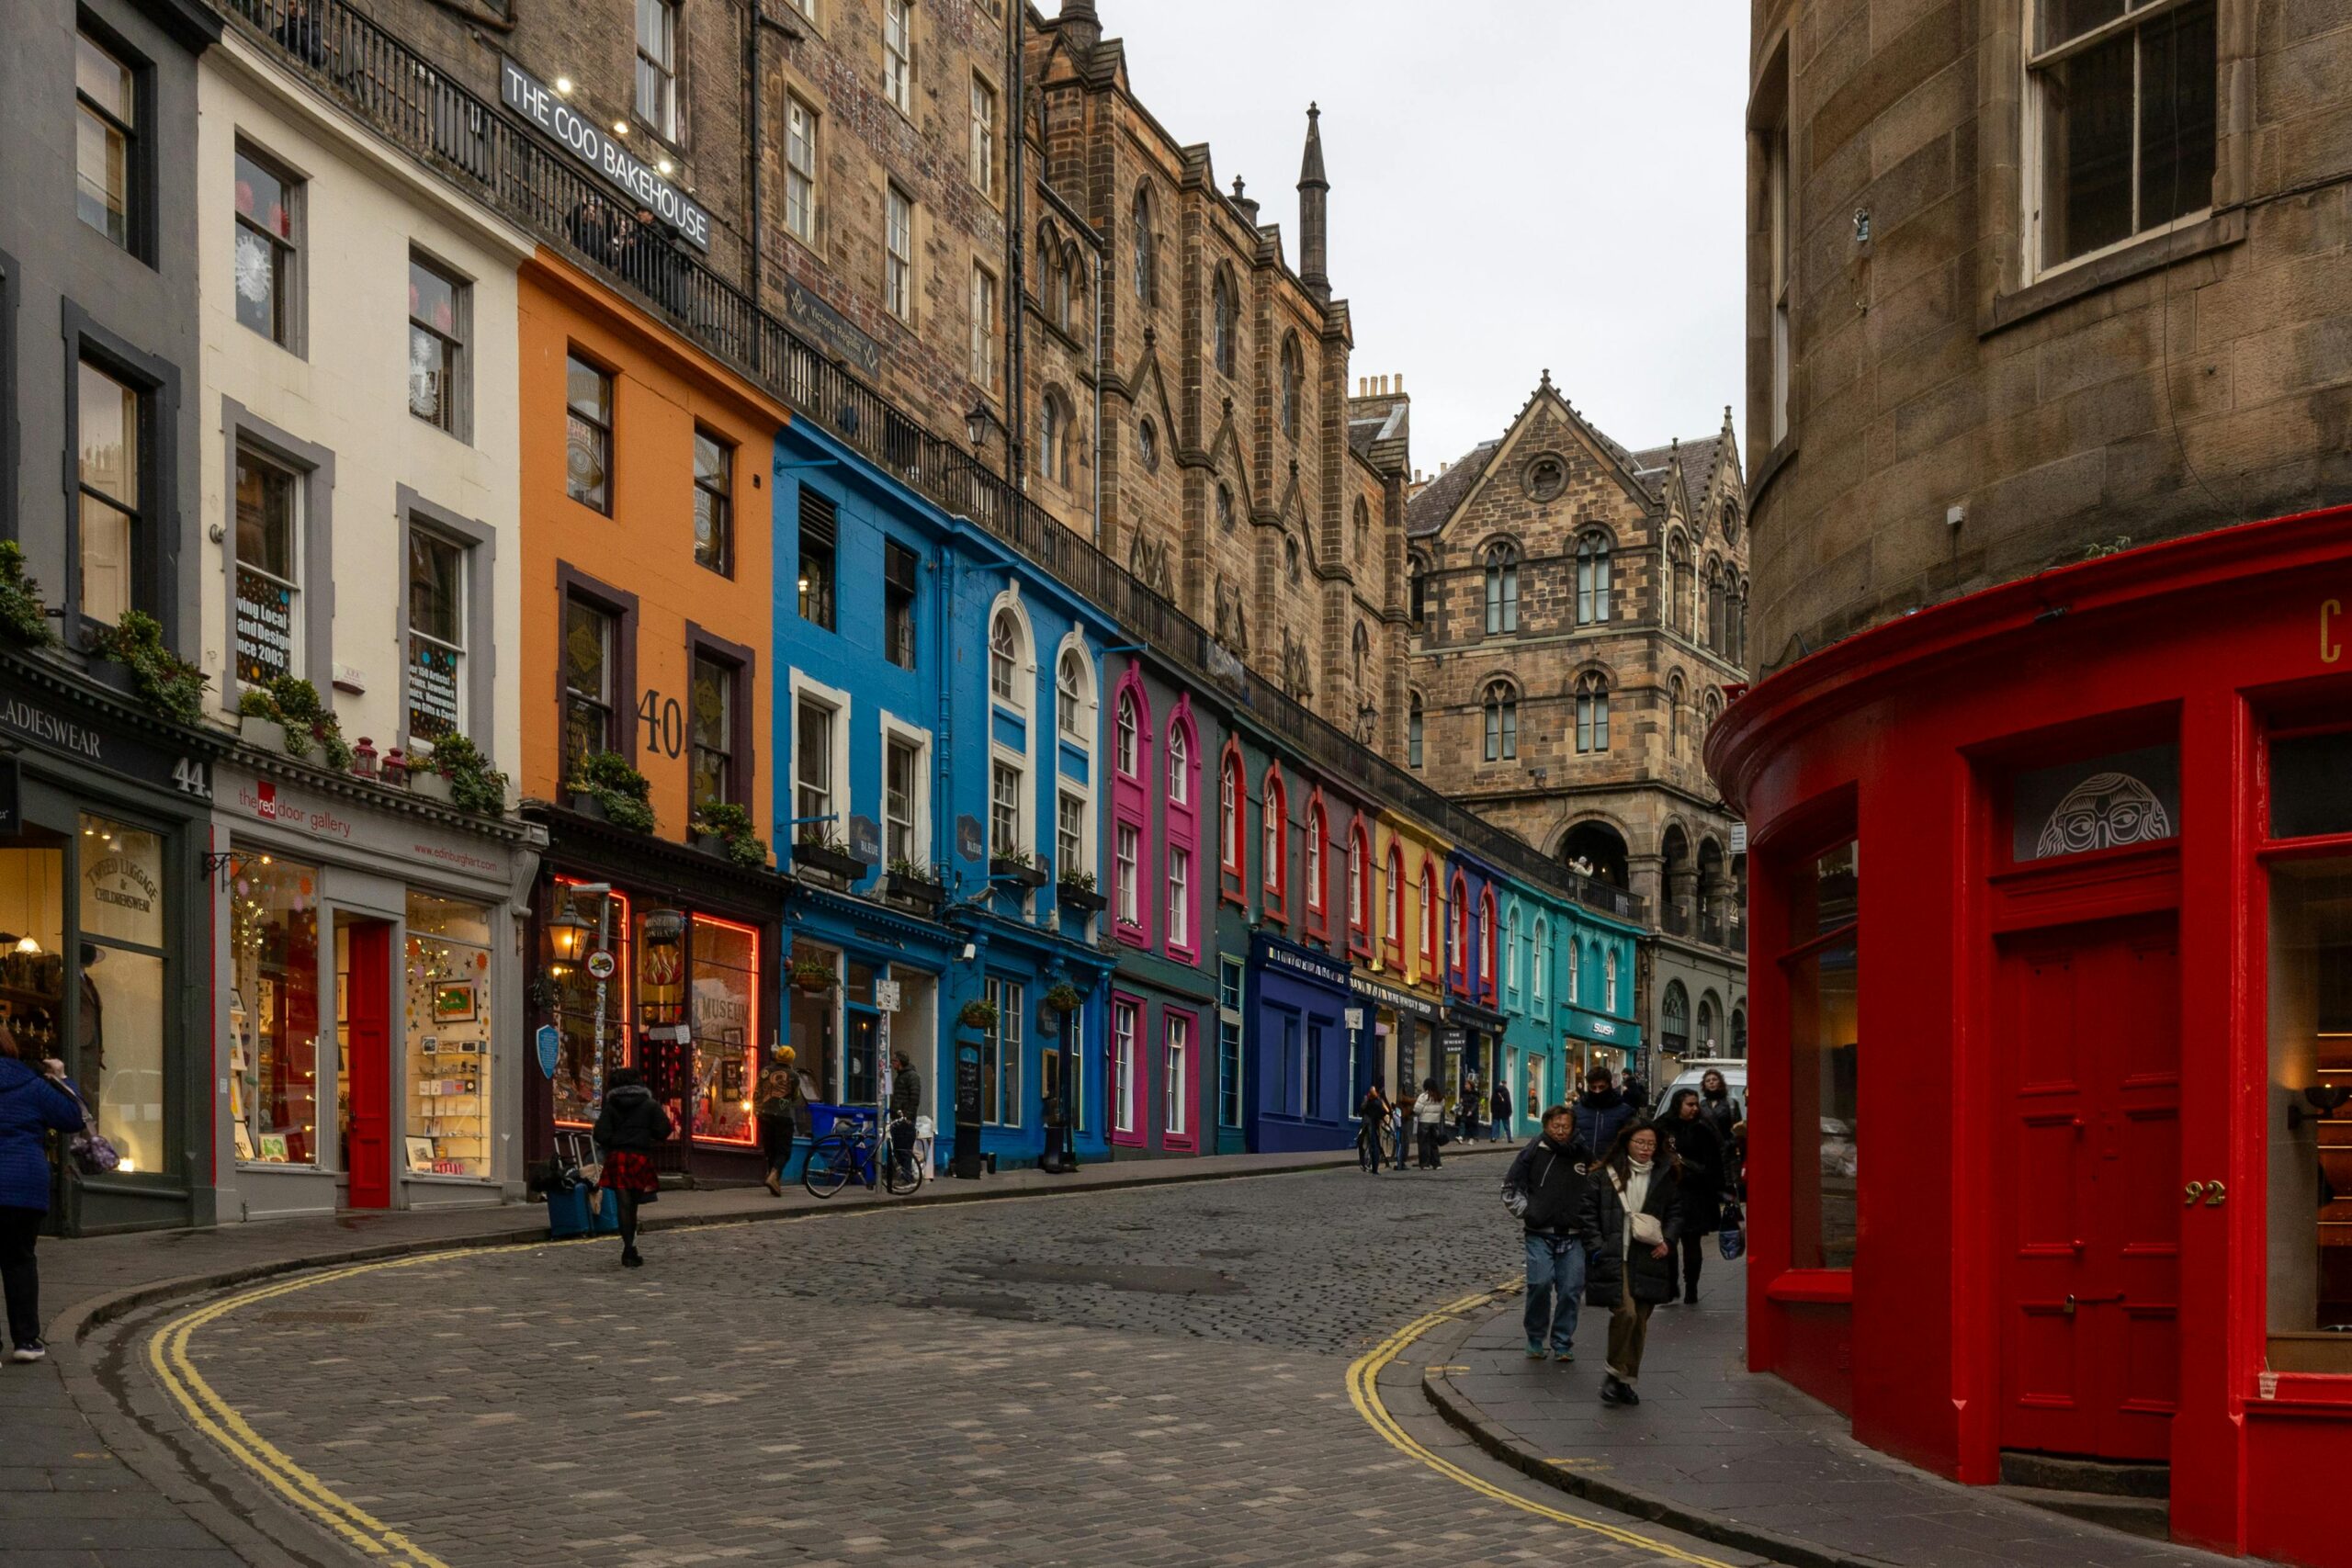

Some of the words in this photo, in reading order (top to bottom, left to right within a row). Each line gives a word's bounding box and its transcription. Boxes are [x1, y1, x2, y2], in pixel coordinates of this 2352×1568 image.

[507, 67, 549, 127] THE
[555, 107, 597, 160] COO
[604, 141, 707, 244] BAKEHOUSE
[810, 304, 836, 333] Victoria
[837, 325, 861, 353] Regalia
[238, 618, 256, 637] and
[261, 604, 287, 629] Local
[258, 644, 284, 668] 2003
[639, 689, 682, 760] 40
[239, 787, 257, 808] the
[258, 795, 275, 814] red
[278, 799, 306, 823] door
[311, 811, 351, 838] gallery
[413, 844, 497, 871] www.edinburghart.com
[860, 840, 878, 856] BLEUE
[967, 839, 982, 855] BLEUE
[120, 858, 158, 902] LUGGAGE
[702, 997, 750, 1026] MUSEUM
[1593, 1022, 1615, 1036] SWISH
[2184, 1180, 2225, 1205] 92
